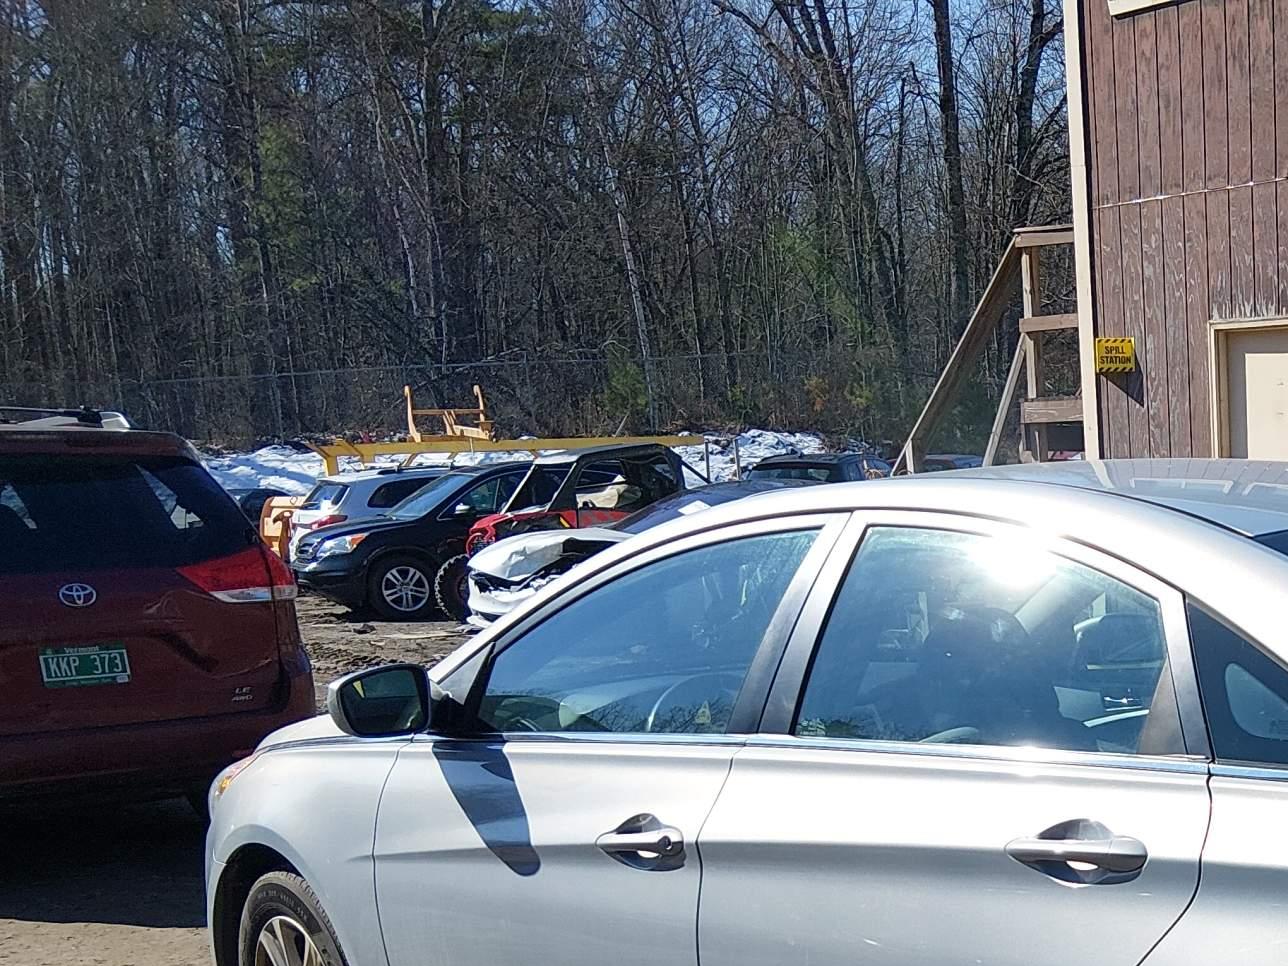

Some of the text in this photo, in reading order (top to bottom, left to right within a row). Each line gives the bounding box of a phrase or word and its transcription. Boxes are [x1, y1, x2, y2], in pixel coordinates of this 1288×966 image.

[1104, 345, 1126, 355] SPILL
[1100, 355, 1132, 365] STATION
[48, 653, 123, 678] KKP 373
